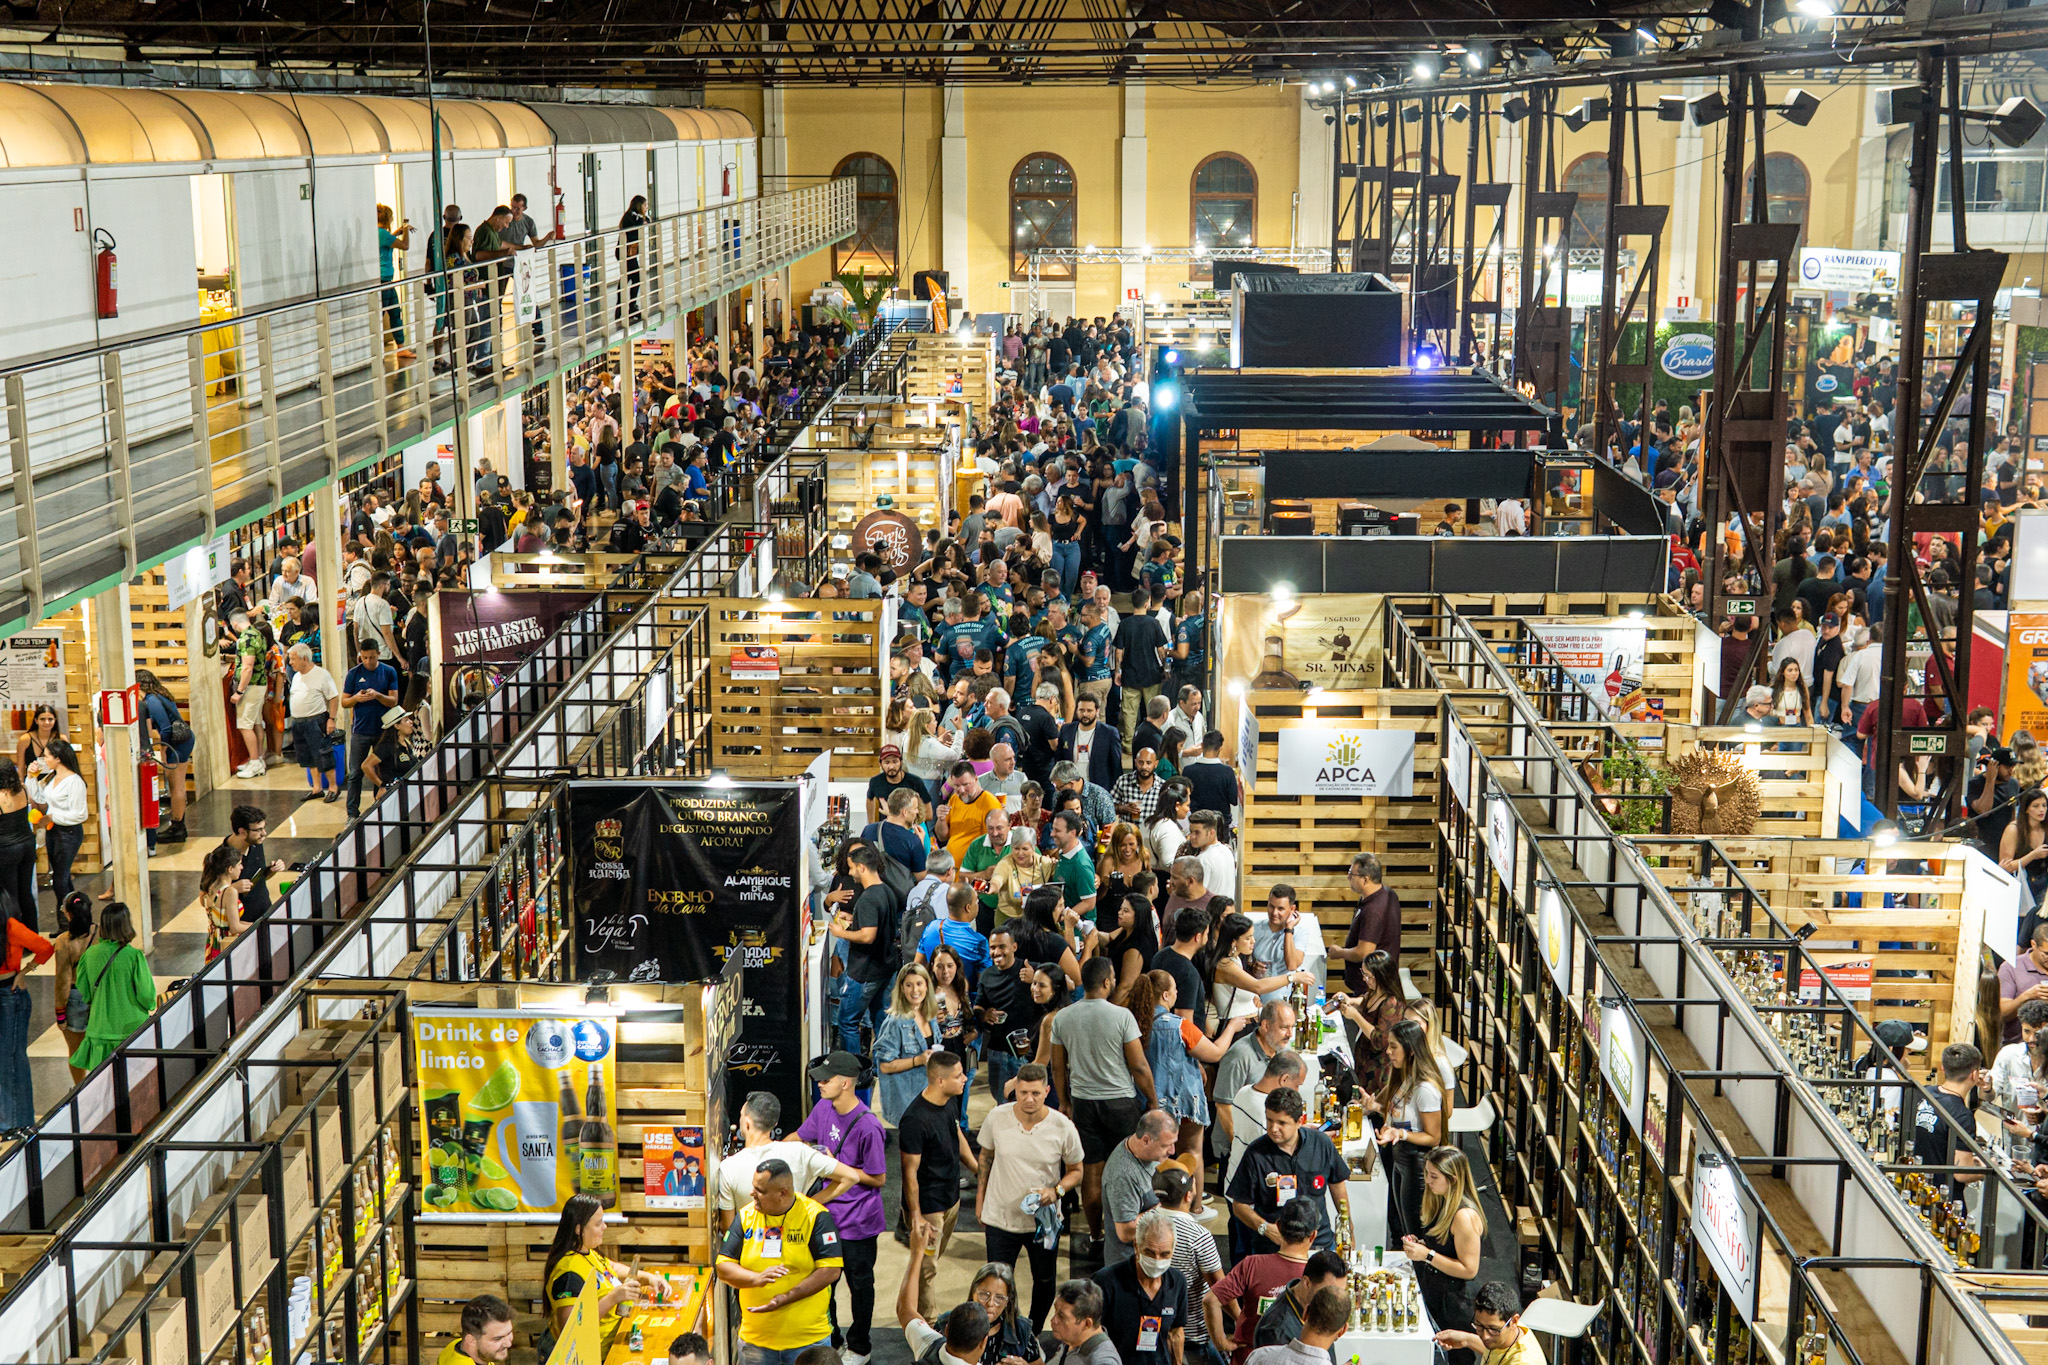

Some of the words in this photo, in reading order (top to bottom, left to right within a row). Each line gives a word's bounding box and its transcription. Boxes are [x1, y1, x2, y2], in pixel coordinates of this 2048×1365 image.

[1666, 348, 1714, 370] Brasil
[454, 626, 500, 644] VISTA
[501, 616, 538, 635] ESTE
[2019, 630, 2048, 644] GR
[452, 626, 546, 658] MOVIMENTO!
[1305, 662, 1326, 672] SR.
[1334, 662, 1374, 672] MINAS
[1316, 768, 1376, 782] APCA
[669, 798, 736, 809] PRODUZIDAS
[740, 800, 756, 809] EM
[678, 811, 714, 821] OURO
[660, 824, 726, 834] DEGUSTADAS
[728, 826, 772, 835] MUNDO
[700, 836, 743, 847] AFORA!
[595, 862, 623, 870] NOSSA
[724, 876, 791, 888] ALAMBIQUE
[648, 888, 714, 903] ENGENHO
[740, 892, 775, 901] MINAS
[654, 901, 669, 914] da
[672, 900, 706, 914] Cana
[585, 916, 626, 953] Vega
[419, 1023, 483, 1042] Drink
[490, 1023, 519, 1042] de
[420, 1050, 485, 1069] limão
[728, 1043, 782, 1073] Chefe
[644, 1133, 673, 1144] USE
[522, 1143, 554, 1157] SANTA
[584, 1158, 608, 1169] SANTA
[787, 1234, 804, 1243] SANTA
